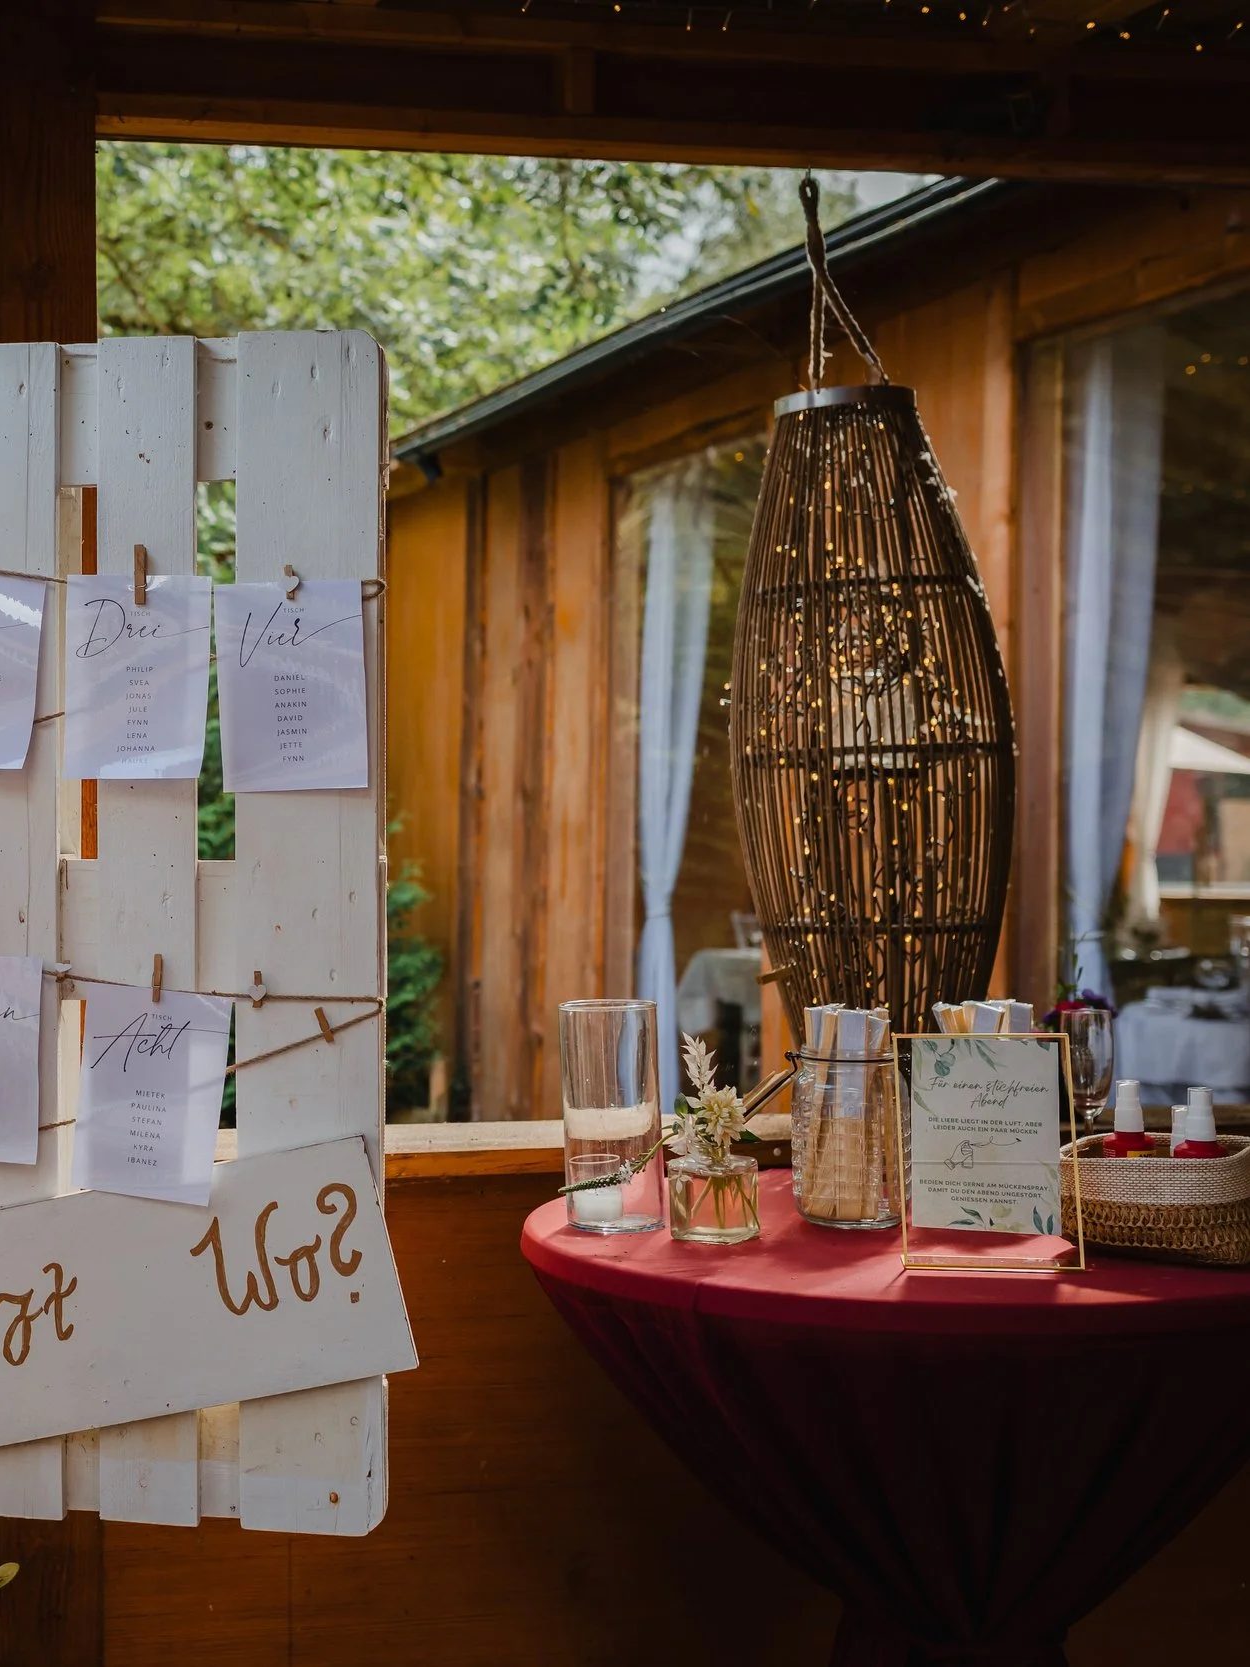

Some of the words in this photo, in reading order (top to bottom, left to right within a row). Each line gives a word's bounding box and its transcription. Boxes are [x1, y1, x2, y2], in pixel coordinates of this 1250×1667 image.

[75, 598, 210, 659] Drei
[239, 601, 362, 668] Vier
[274, 674, 306, 682] DANIEL
[274, 687, 306, 695] SOPHIE
[274, 701, 307, 709] ANAKIN
[128, 706, 148, 714] JULE
[277, 714, 303, 722] DAVID
[277, 728, 308, 737] JASMIN
[280, 742, 303, 750] JETTE
[90, 1012, 229, 1072] Acht
[929, 1076, 949, 1091] Für
[953, 1081, 982, 1089] einen
[986, 1079, 1049, 1097] stichfreien
[135, 1090, 166, 1099] MIETEK
[971, 1092, 1009, 1109] Abend
[130, 1103, 167, 1112] PAULINA
[131, 1116, 163, 1126] STEFAN
[129, 1130, 161, 1139] MILENA
[1010, 1127, 1038, 1135] MÜCKEN
[133, 1144, 154, 1152] KYRA
[127, 1157, 158, 1167] IBANEZ
[190, 1182, 362, 1317] Wo?
